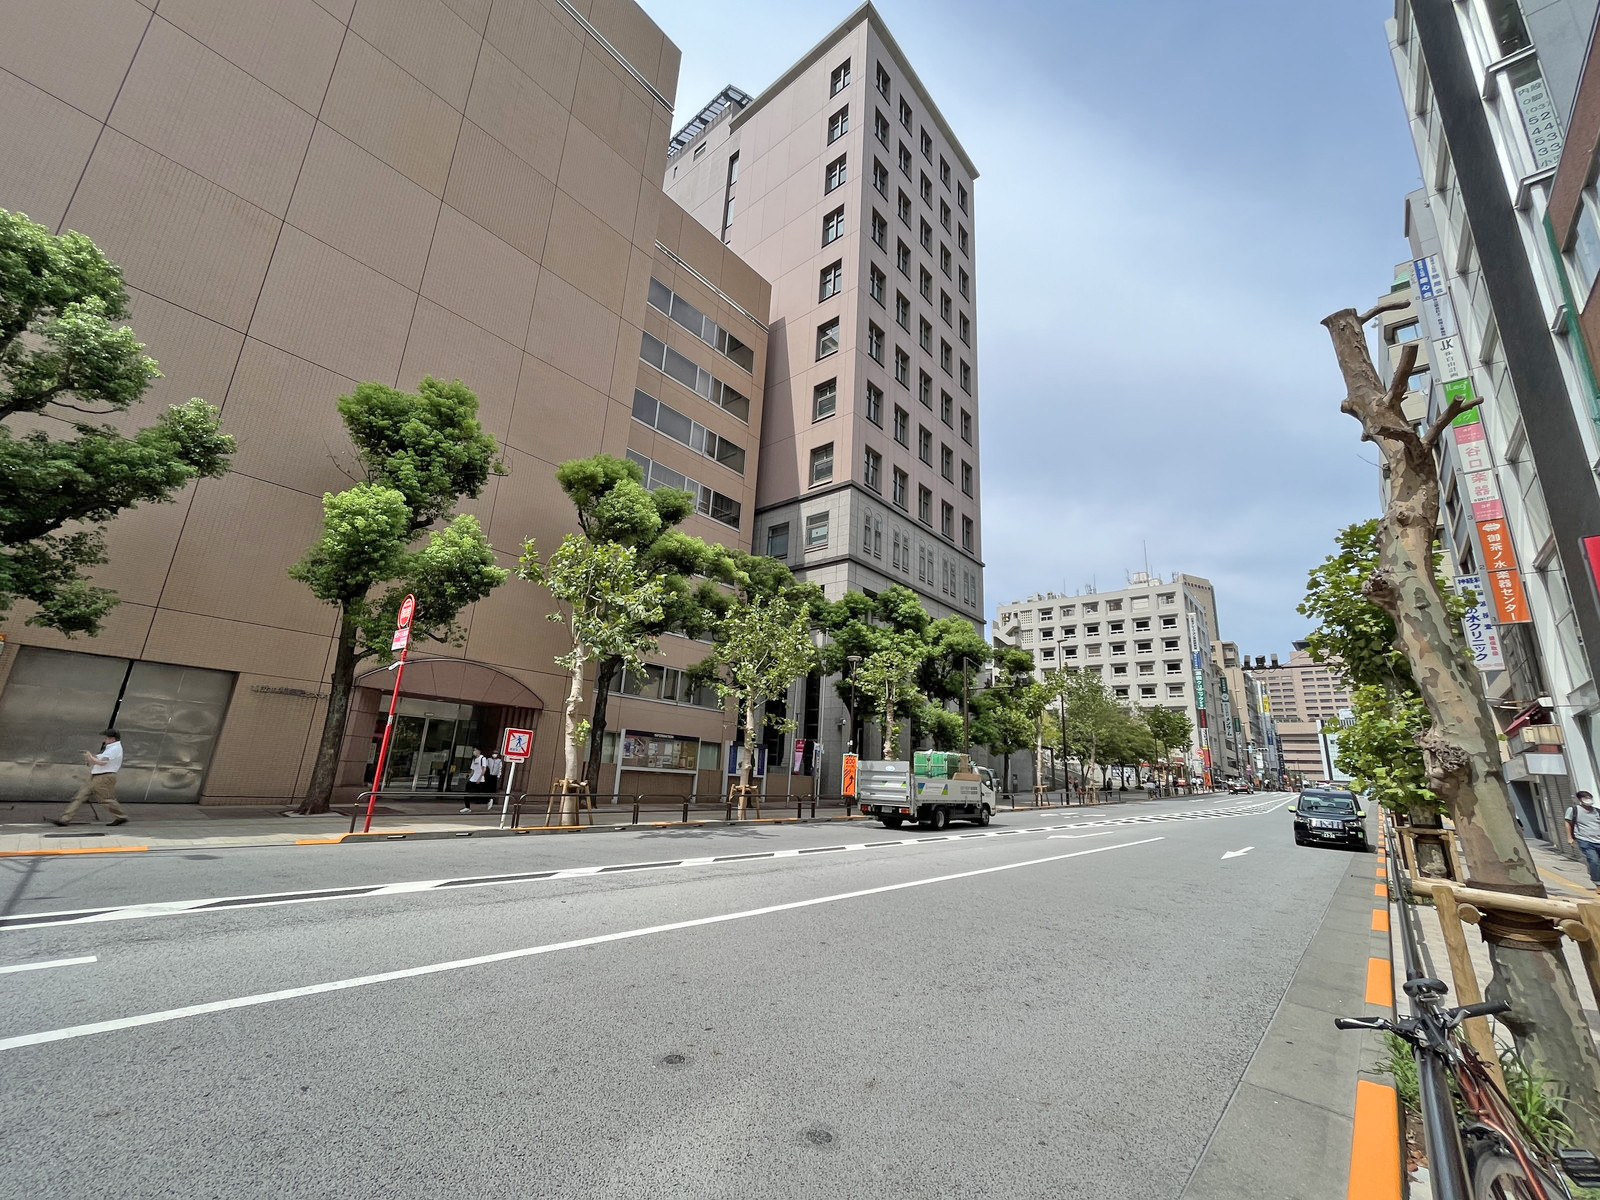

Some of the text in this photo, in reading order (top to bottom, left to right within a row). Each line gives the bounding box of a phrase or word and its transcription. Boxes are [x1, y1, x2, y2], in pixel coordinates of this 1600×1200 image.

[1528, 111, 1551, 125] 52
[1531, 122, 1554, 135] 44
[1535, 132, 1557, 145] 53
[1538, 142, 1561, 156] 33
